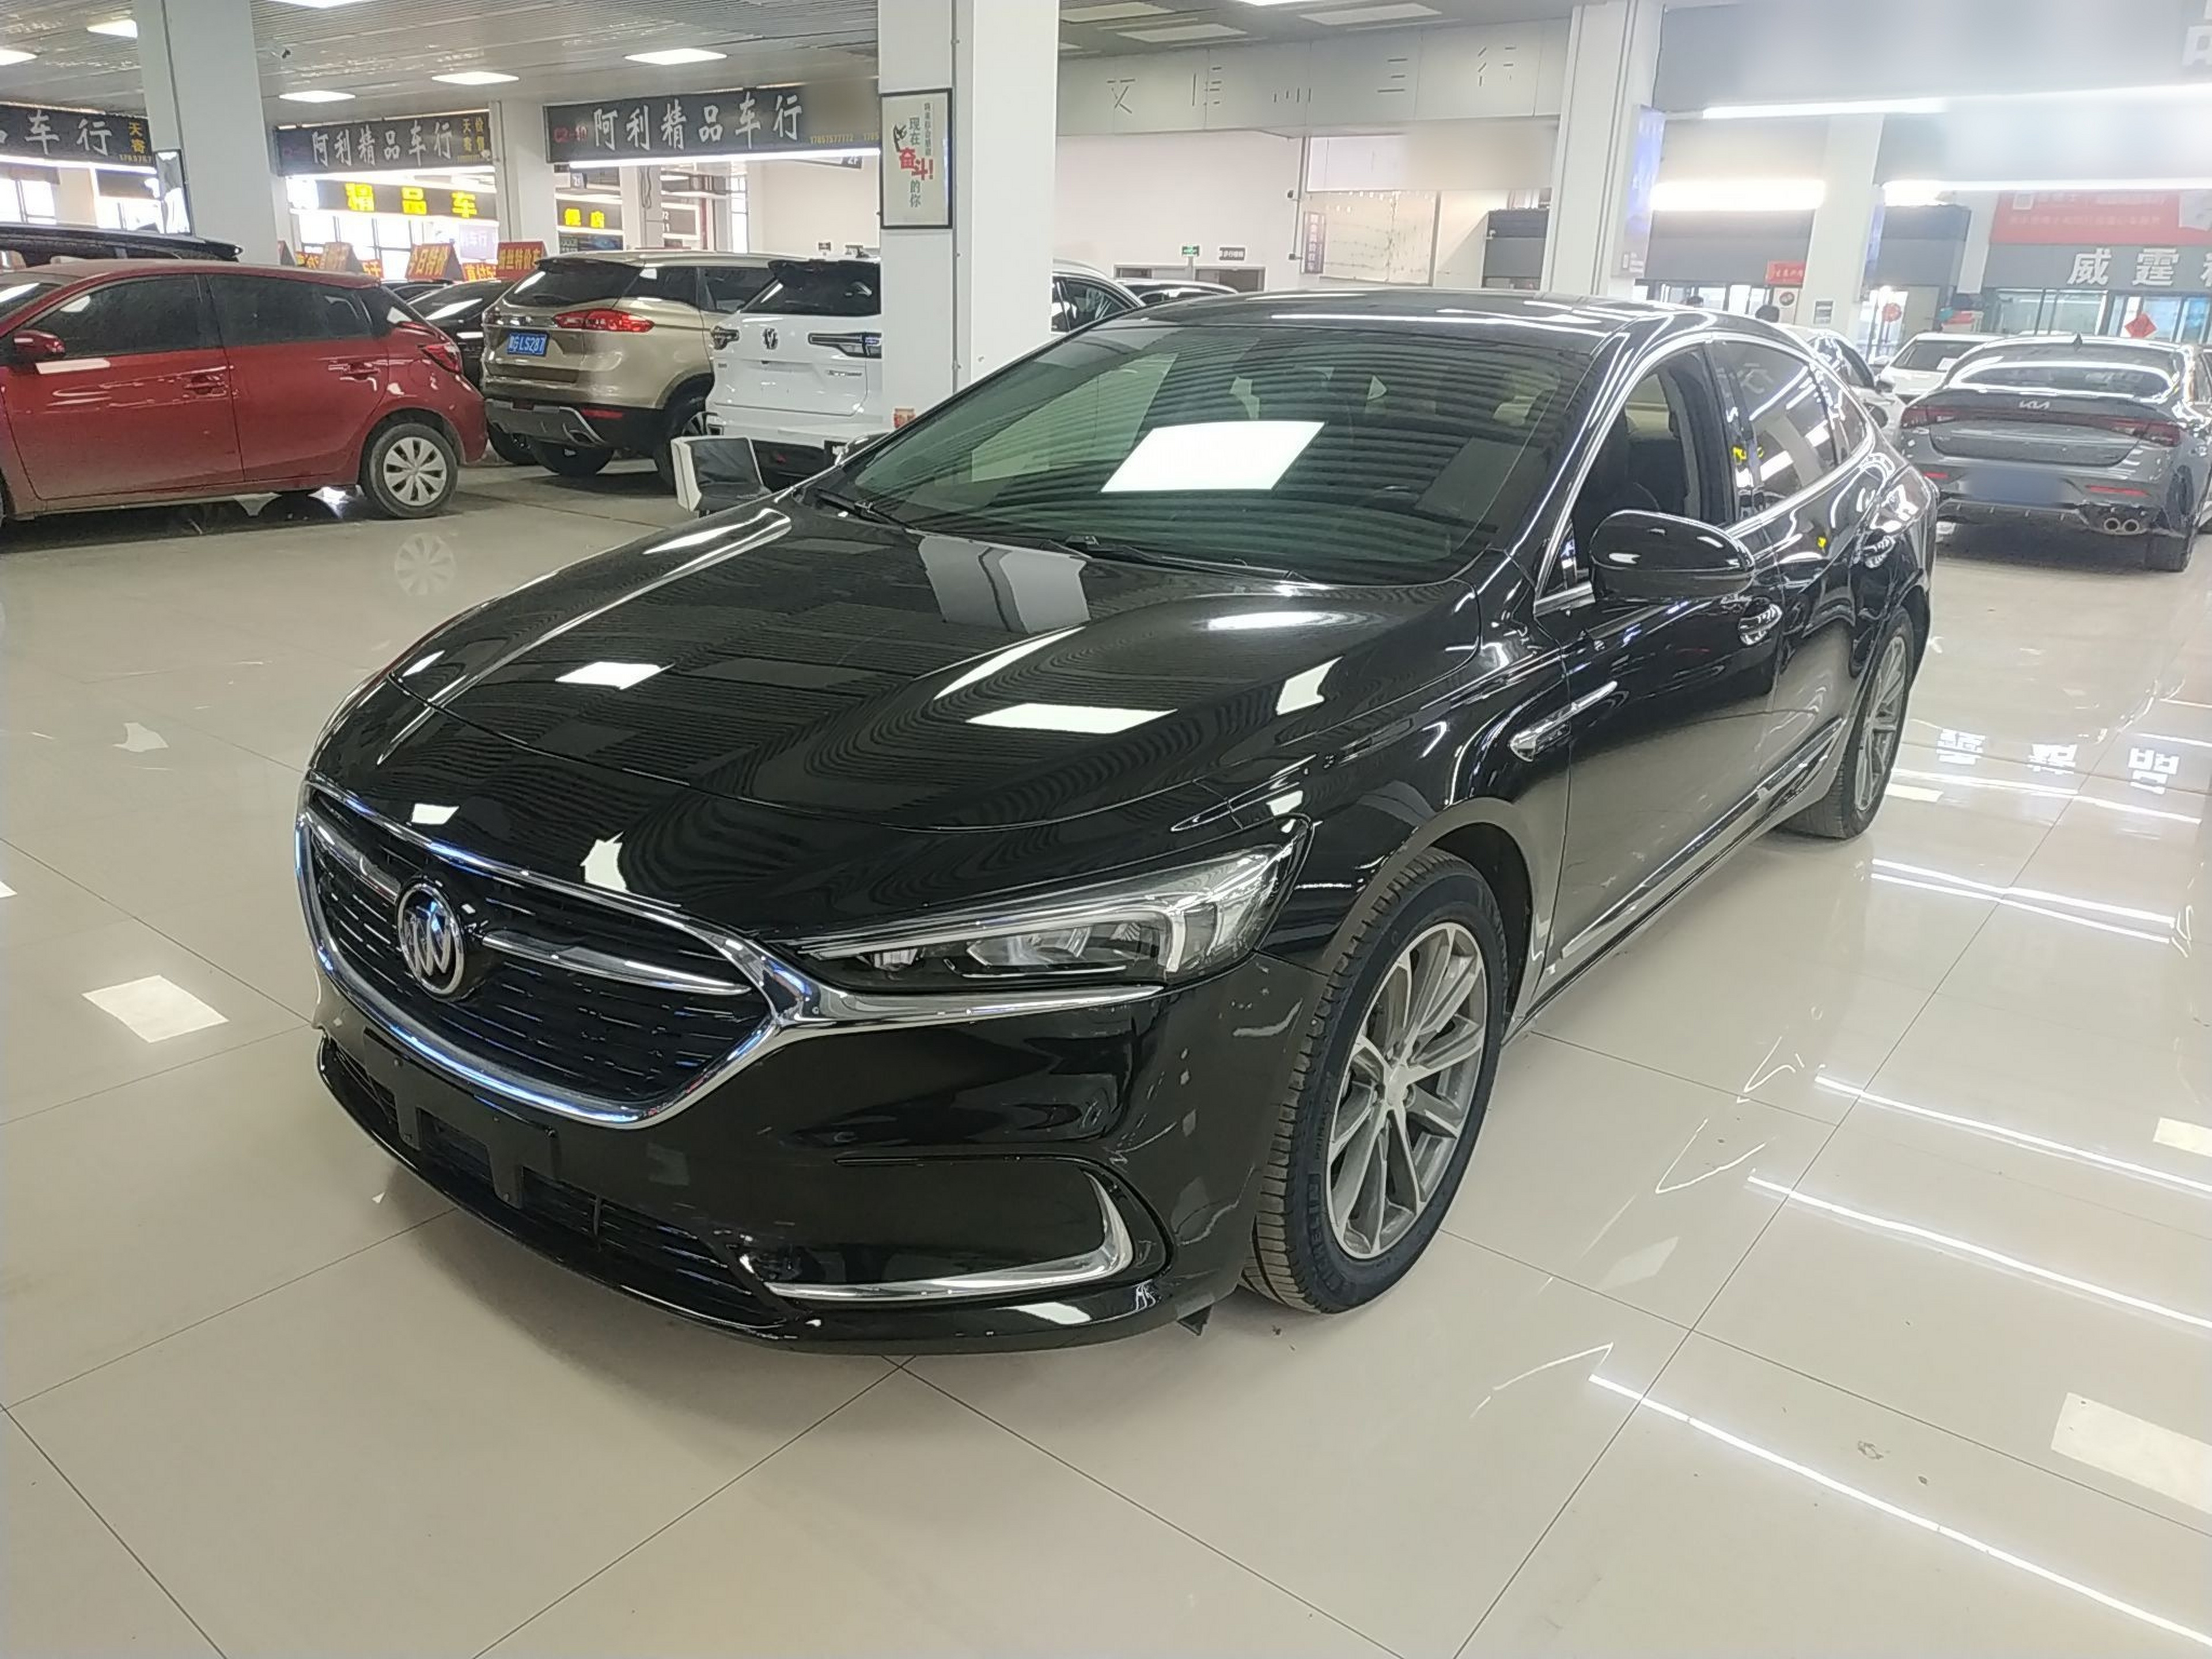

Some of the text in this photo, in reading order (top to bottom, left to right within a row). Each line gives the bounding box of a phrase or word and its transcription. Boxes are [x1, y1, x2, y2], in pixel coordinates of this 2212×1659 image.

[0, 109, 112, 156] 车行
[594, 91, 802, 151] 阿利精品车行
[909, 117, 921, 145] 现在
[312, 120, 453, 166] 阿利精品车行
[909, 180, 922, 207] 的你
[465, 263, 496, 281] 首付5
